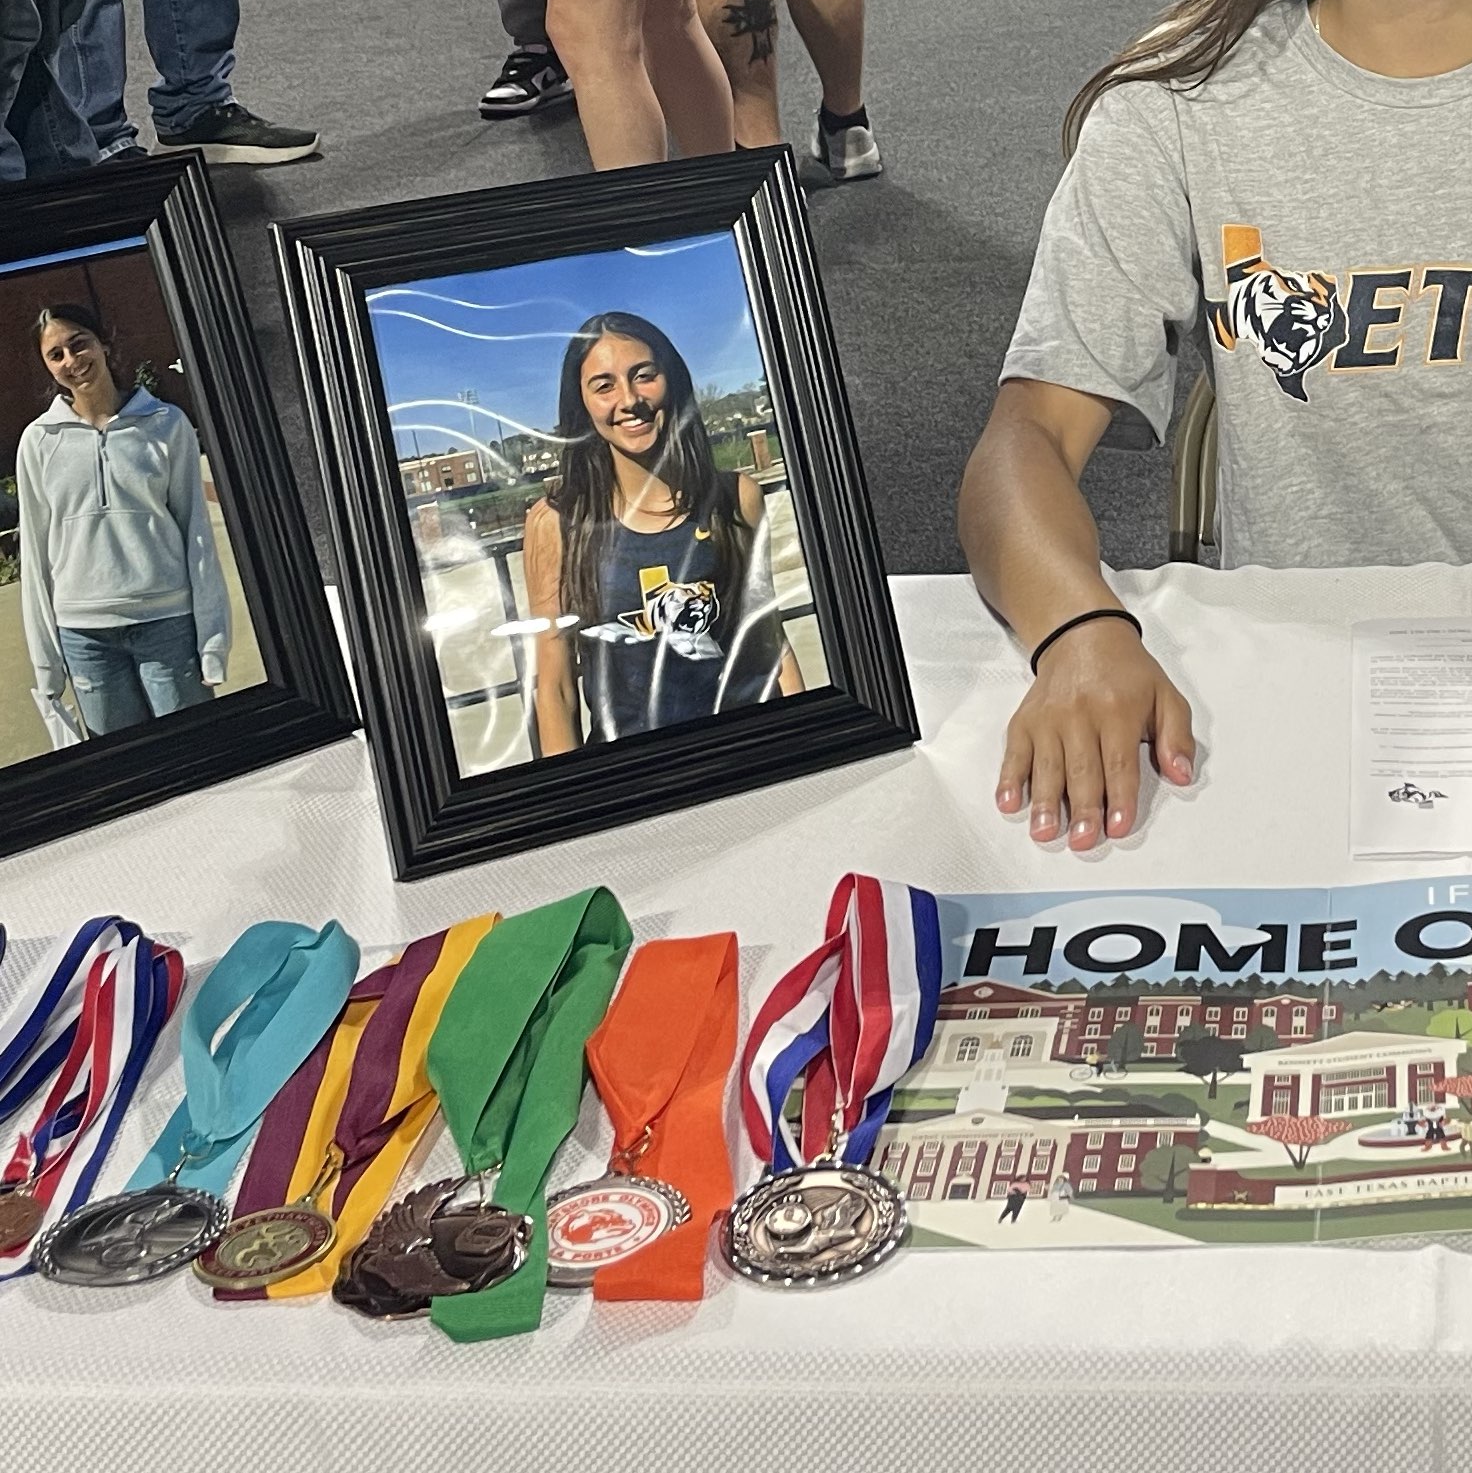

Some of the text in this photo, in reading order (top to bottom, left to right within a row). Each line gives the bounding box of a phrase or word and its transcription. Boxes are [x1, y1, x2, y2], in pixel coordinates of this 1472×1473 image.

[963, 920, 1358, 977] HOME
[1305, 1187, 1344, 1199] EAST
[1356, 1179, 1408, 1194] TEXAS
